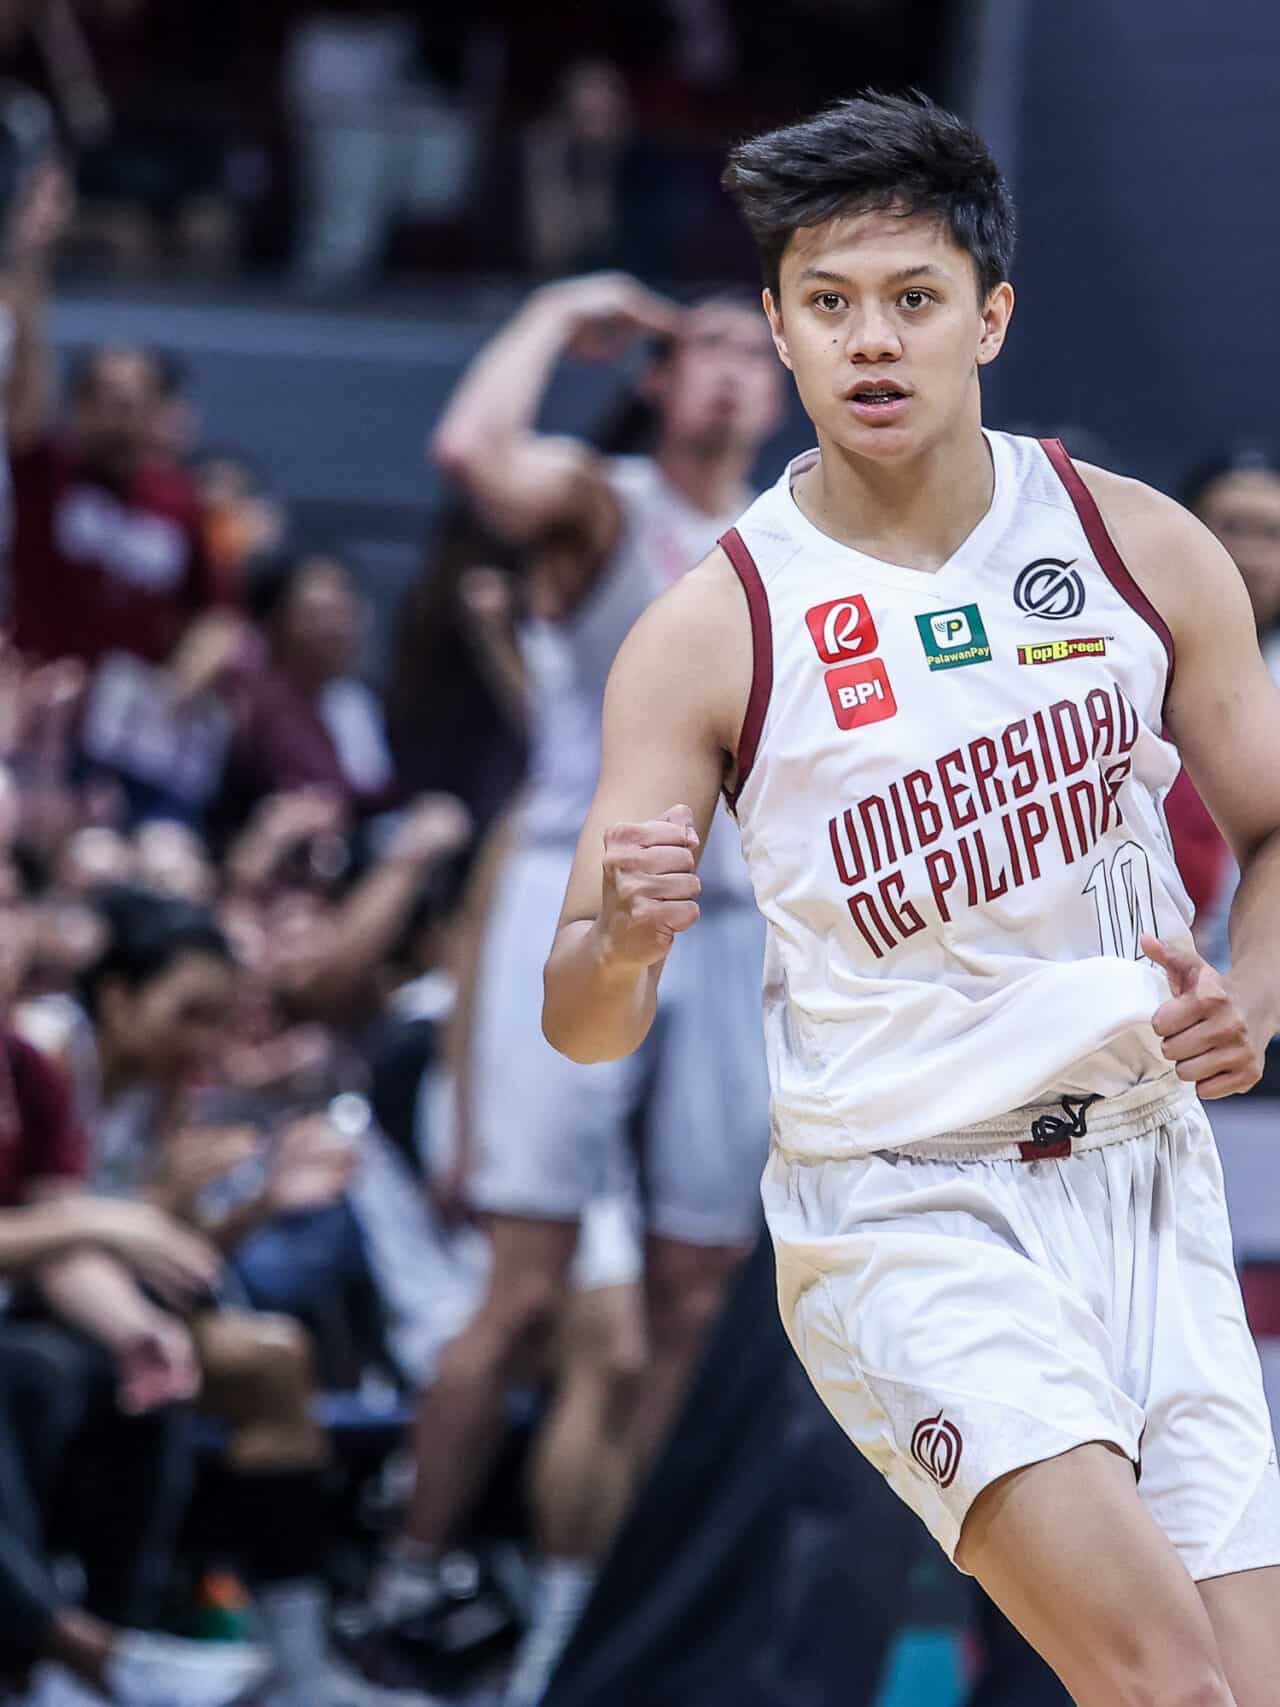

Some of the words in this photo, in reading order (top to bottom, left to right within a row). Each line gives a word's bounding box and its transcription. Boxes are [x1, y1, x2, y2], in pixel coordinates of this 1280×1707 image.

[927, 645, 990, 665] PalawanPay
[1017, 639, 1104, 664] TopBreed
[837, 679, 885, 710] BPI
[828, 681, 1139, 887] UNIBERSIDAD
[847, 869, 928, 959] NG
